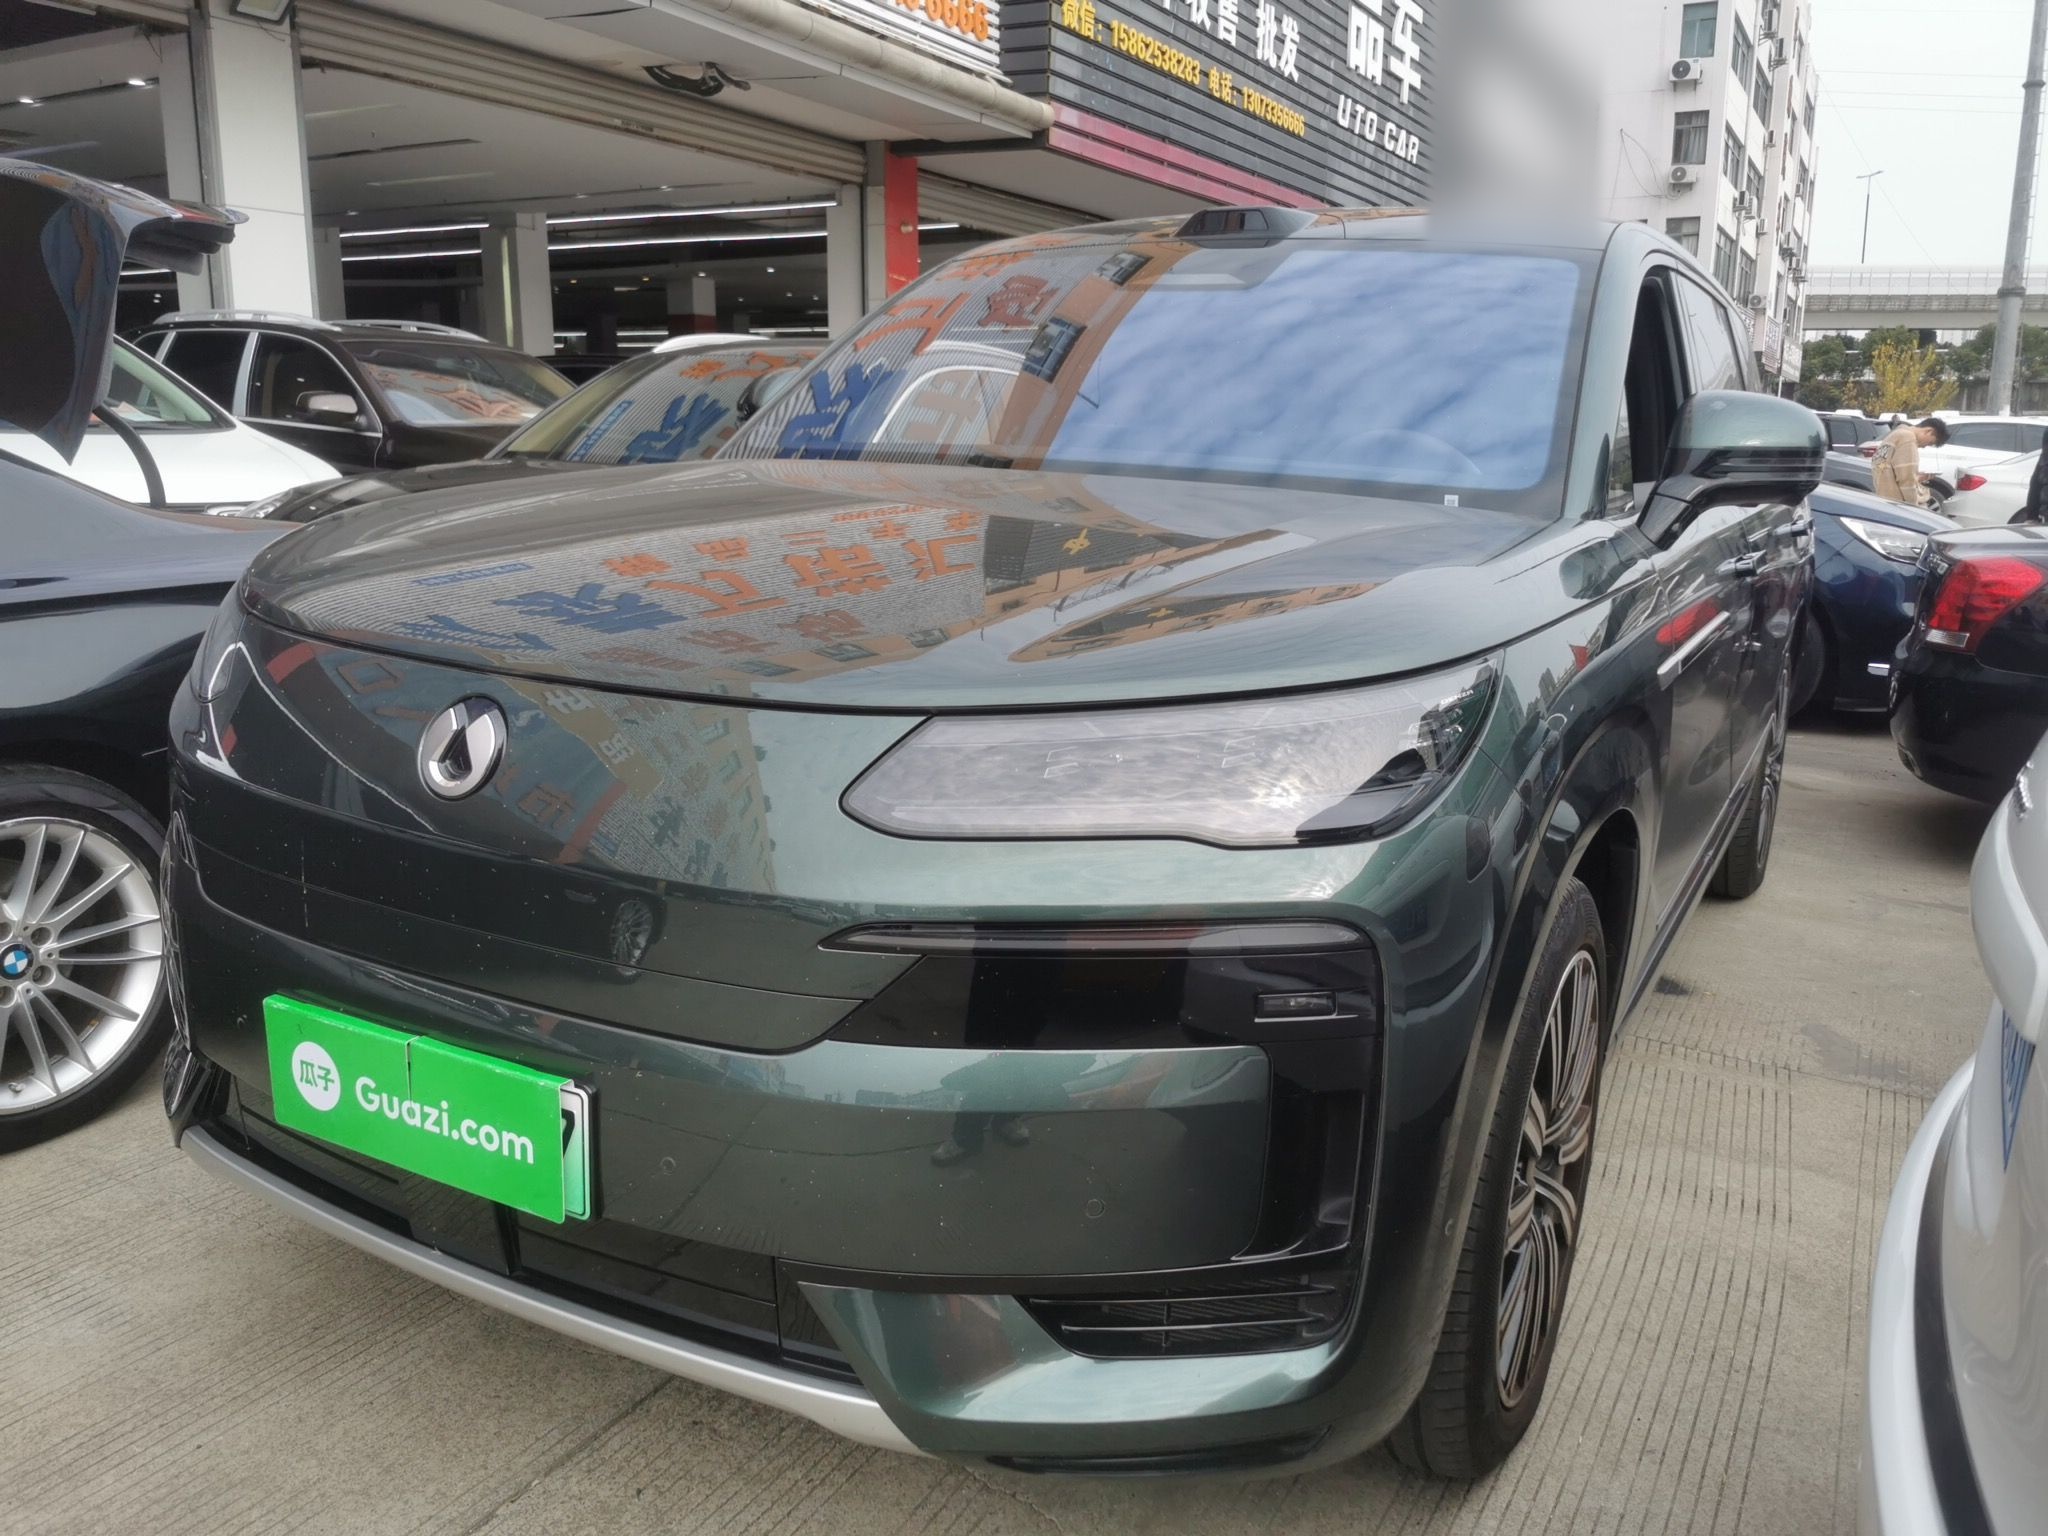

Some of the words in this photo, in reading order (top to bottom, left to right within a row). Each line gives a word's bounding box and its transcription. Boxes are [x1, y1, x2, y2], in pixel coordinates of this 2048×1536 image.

[1256, 0, 1300, 83] 批发
[1337, 94, 1378, 142] UTO
[1383, 121, 1420, 165] CAR
[299, 1059, 336, 1092] 瓜子
[355, 1076, 535, 1165] Guazi.com
